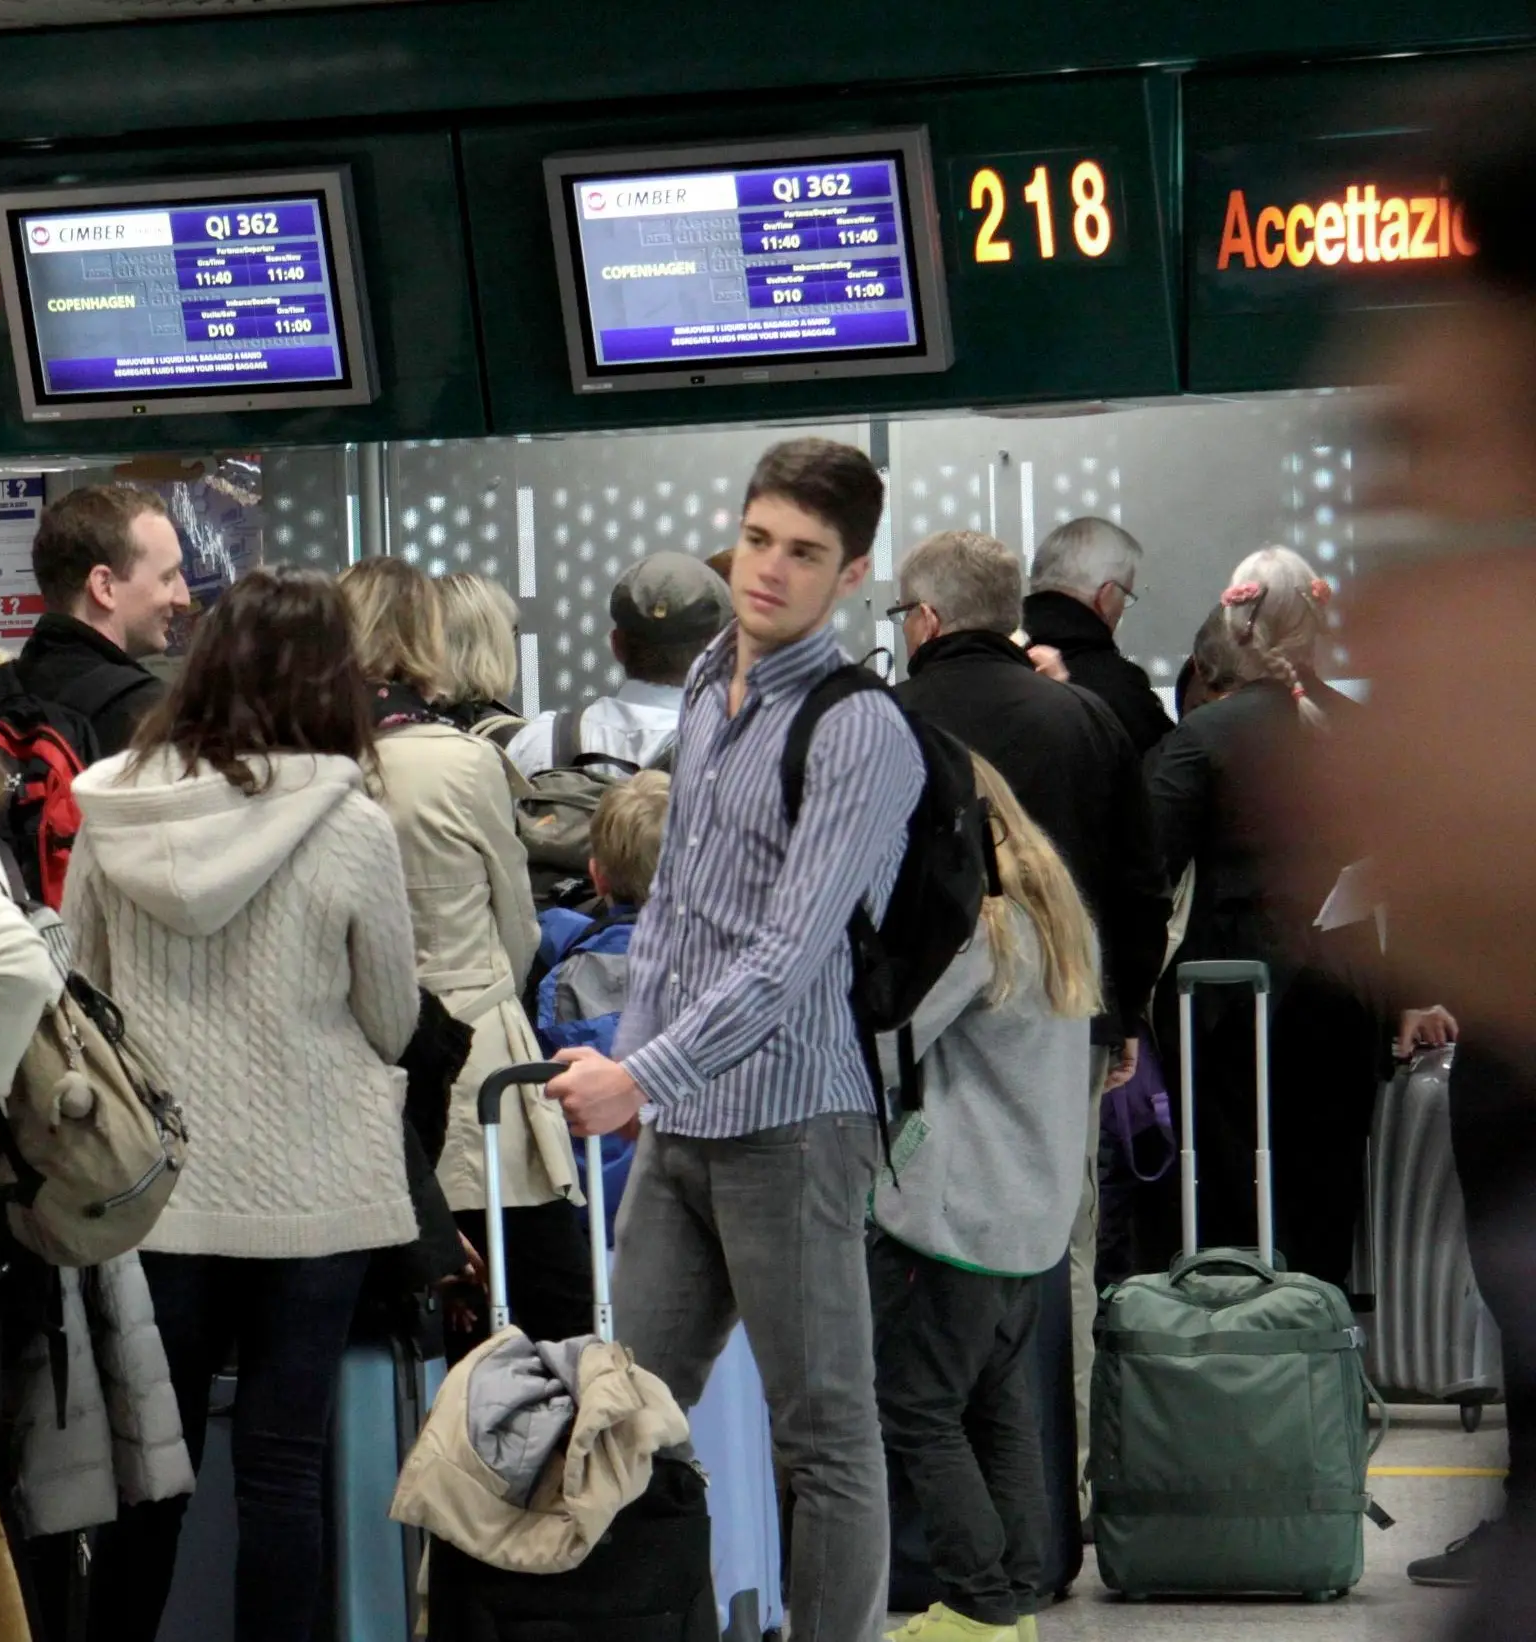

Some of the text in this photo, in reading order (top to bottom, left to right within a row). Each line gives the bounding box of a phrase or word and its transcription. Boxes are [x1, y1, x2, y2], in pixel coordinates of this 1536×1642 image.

[806, 173, 852, 199] 362
[616, 188, 687, 208] CIMBER
[970, 161, 1112, 262] 218
[237, 213, 279, 236] 362
[59, 224, 125, 243] CIMBER
[838, 229, 878, 245] 11:40
[761, 234, 800, 251] 11:40
[268, 266, 305, 282] 11:40
[601, 260, 696, 280] COPENHAGEN
[196, 271, 232, 286] 11:40
[772, 289, 802, 304] D10
[845, 283, 885, 299] 11:00
[47, 295, 136, 312] COPENHAGEN
[208, 323, 235, 338] D10
[275, 319, 312, 334] 11:00
[801, 319, 807, 327] A
[759, 332, 779, 341] YOUR
[196, 364, 214, 373] YOUR
[16, 480, 27, 499] ?
[11, 597, 20, 615] ?
